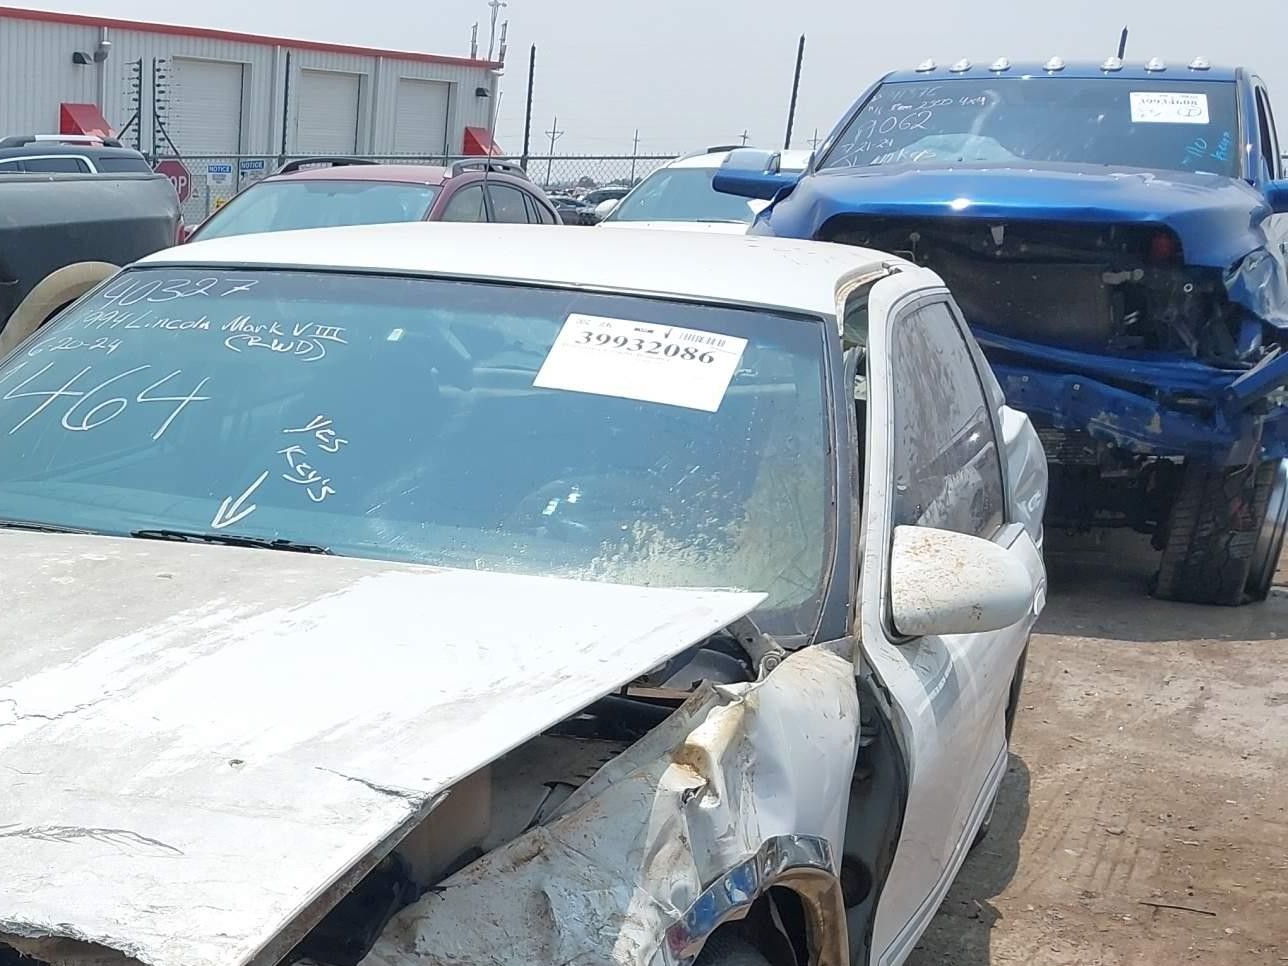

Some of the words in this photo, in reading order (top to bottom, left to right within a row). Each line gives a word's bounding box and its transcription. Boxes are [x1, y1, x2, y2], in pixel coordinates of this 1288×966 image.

[208, 165, 231, 173] NOTICE
[241, 161, 263, 169] NOTICE
[170, 175, 188, 194] OP
[103, 277, 260, 309] 40327
[221, 314, 285, 336] Mark
[223, 333, 327, 362] (RWD)
[574, 330, 716, 365] 39932086
